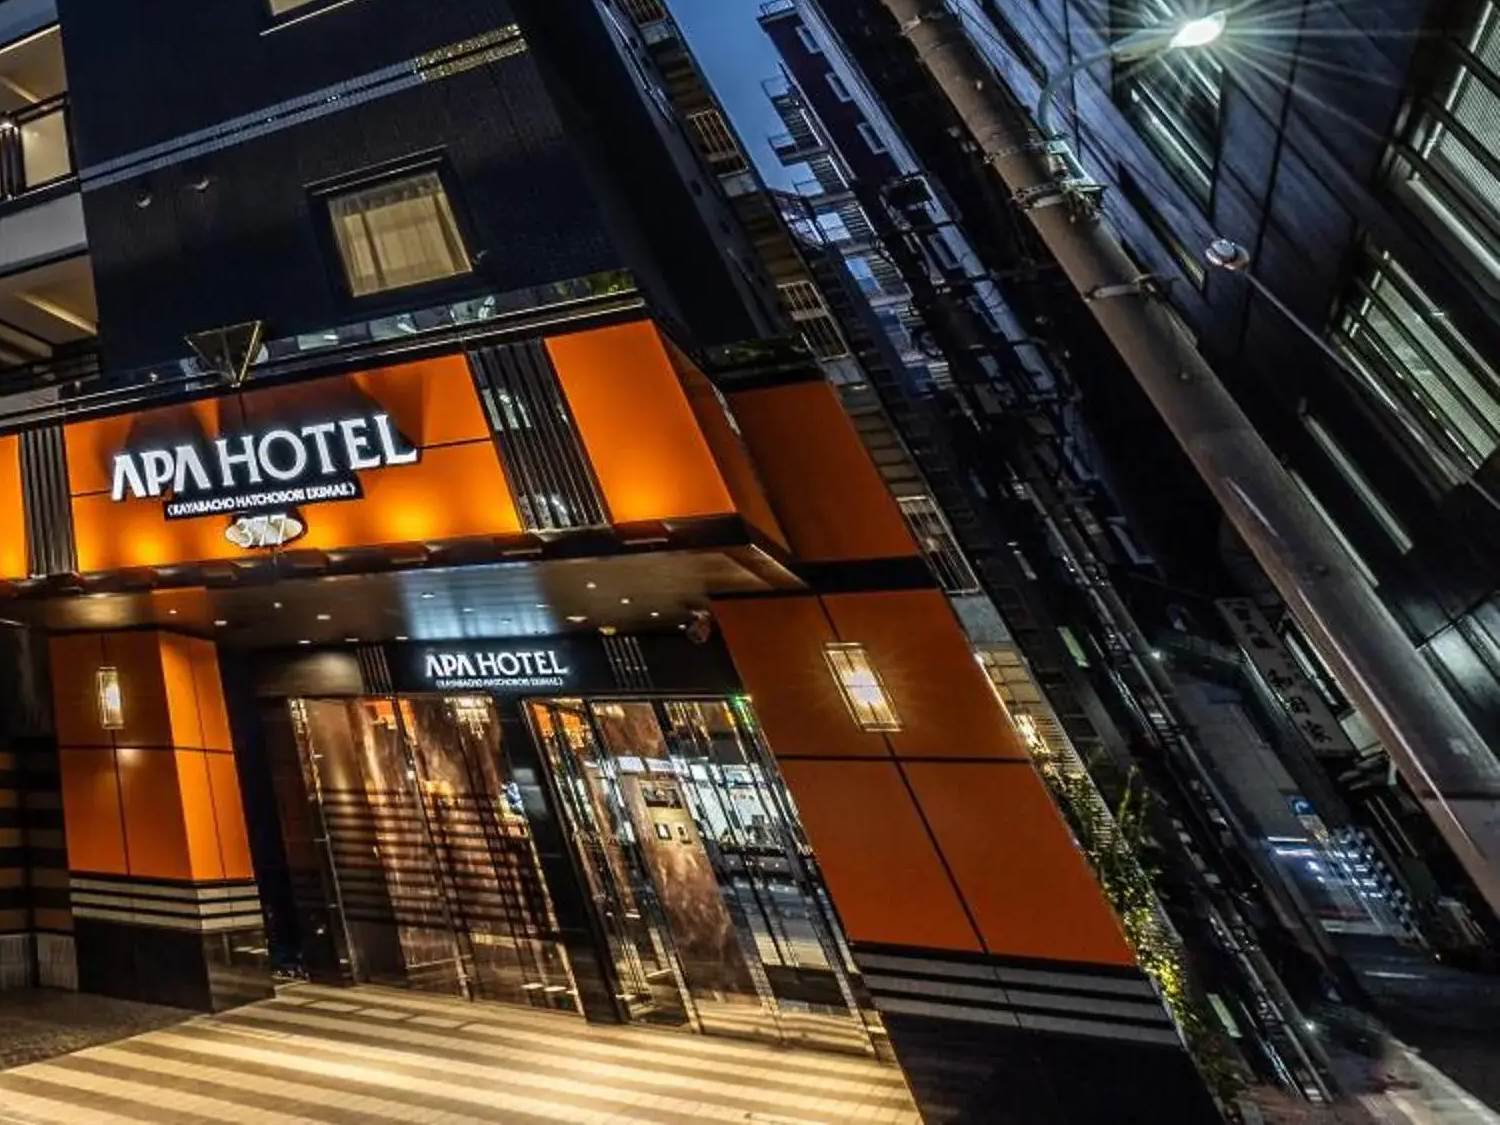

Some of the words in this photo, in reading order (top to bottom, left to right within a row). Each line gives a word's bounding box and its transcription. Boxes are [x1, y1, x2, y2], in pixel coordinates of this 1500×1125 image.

[111, 444, 211, 501] APA
[215, 414, 418, 486] HOTEL
[425, 653, 477, 677] APA
[476, 650, 569, 676] HOTEL
